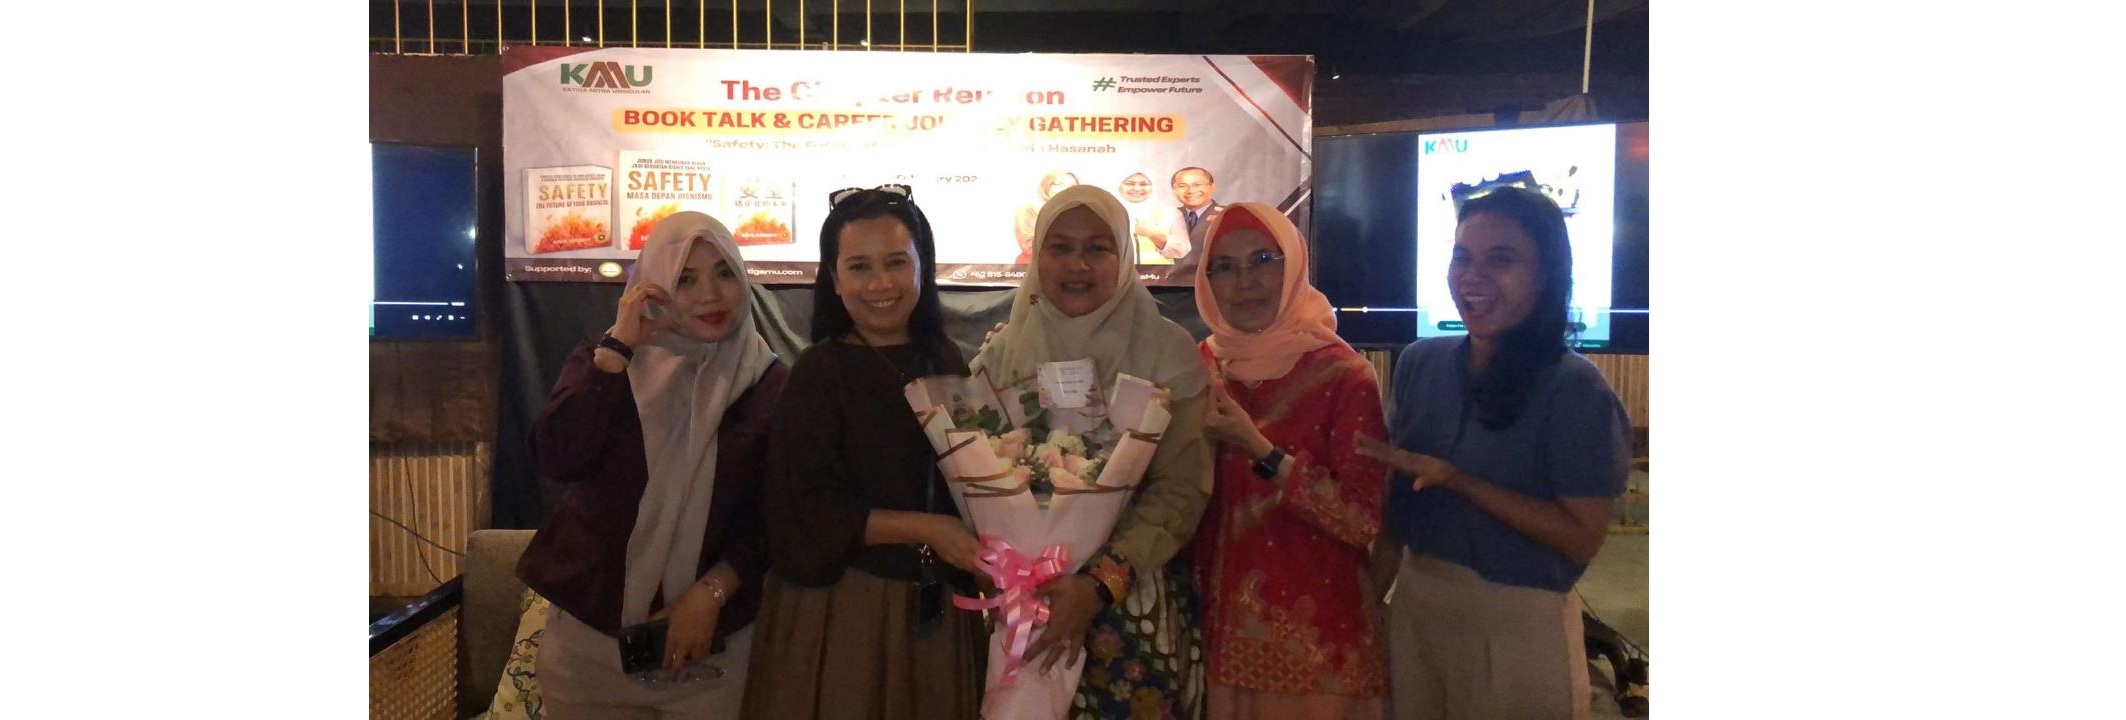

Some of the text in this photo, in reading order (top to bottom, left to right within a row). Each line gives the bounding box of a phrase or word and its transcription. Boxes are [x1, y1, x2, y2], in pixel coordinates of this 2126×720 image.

[1161, 76, 1201, 84] Experts
[720, 80, 782, 101] The
[1117, 86, 1168, 94] Empower
[624, 110, 696, 127] BOOK
[702, 112, 766, 128] TALK
[773, 113, 791, 129] &
[1029, 116, 1174, 134] GATHERING
[1048, 144, 1117, 154] Hasanah
[628, 170, 711, 192] SAFETY
[538, 183, 608, 201] SAFETY
[651, 192, 675, 200] DEPAN
[524, 265, 592, 273] Supported by:
